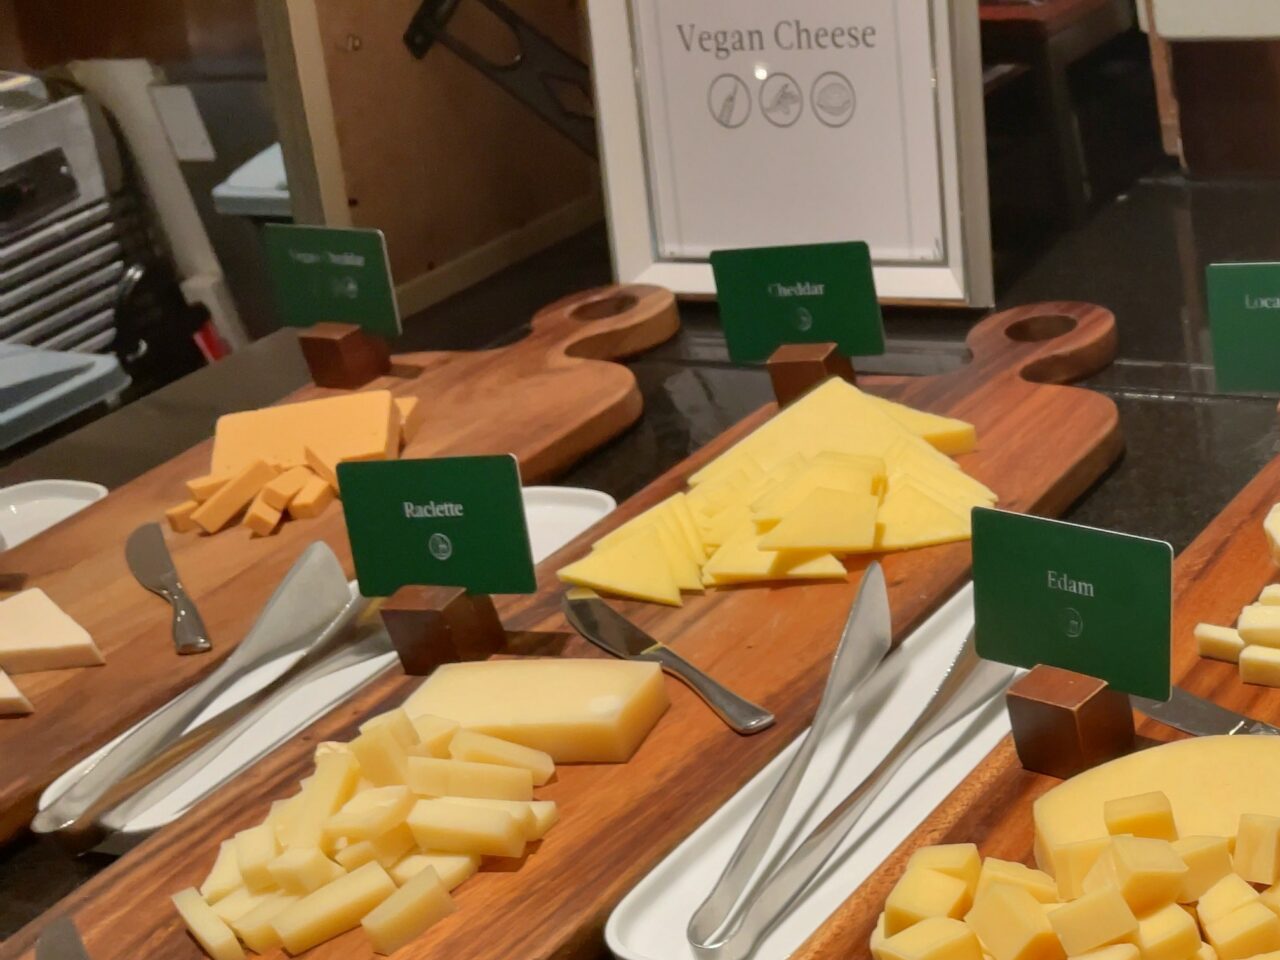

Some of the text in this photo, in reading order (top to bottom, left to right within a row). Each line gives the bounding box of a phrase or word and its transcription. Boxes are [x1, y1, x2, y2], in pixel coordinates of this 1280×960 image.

[677, 18, 877, 61] Vegan Cheese
[767, 281, 825, 297] Cheddar
[402, 500, 464, 519] Raclette
[1047, 569, 1095, 598] Edam
